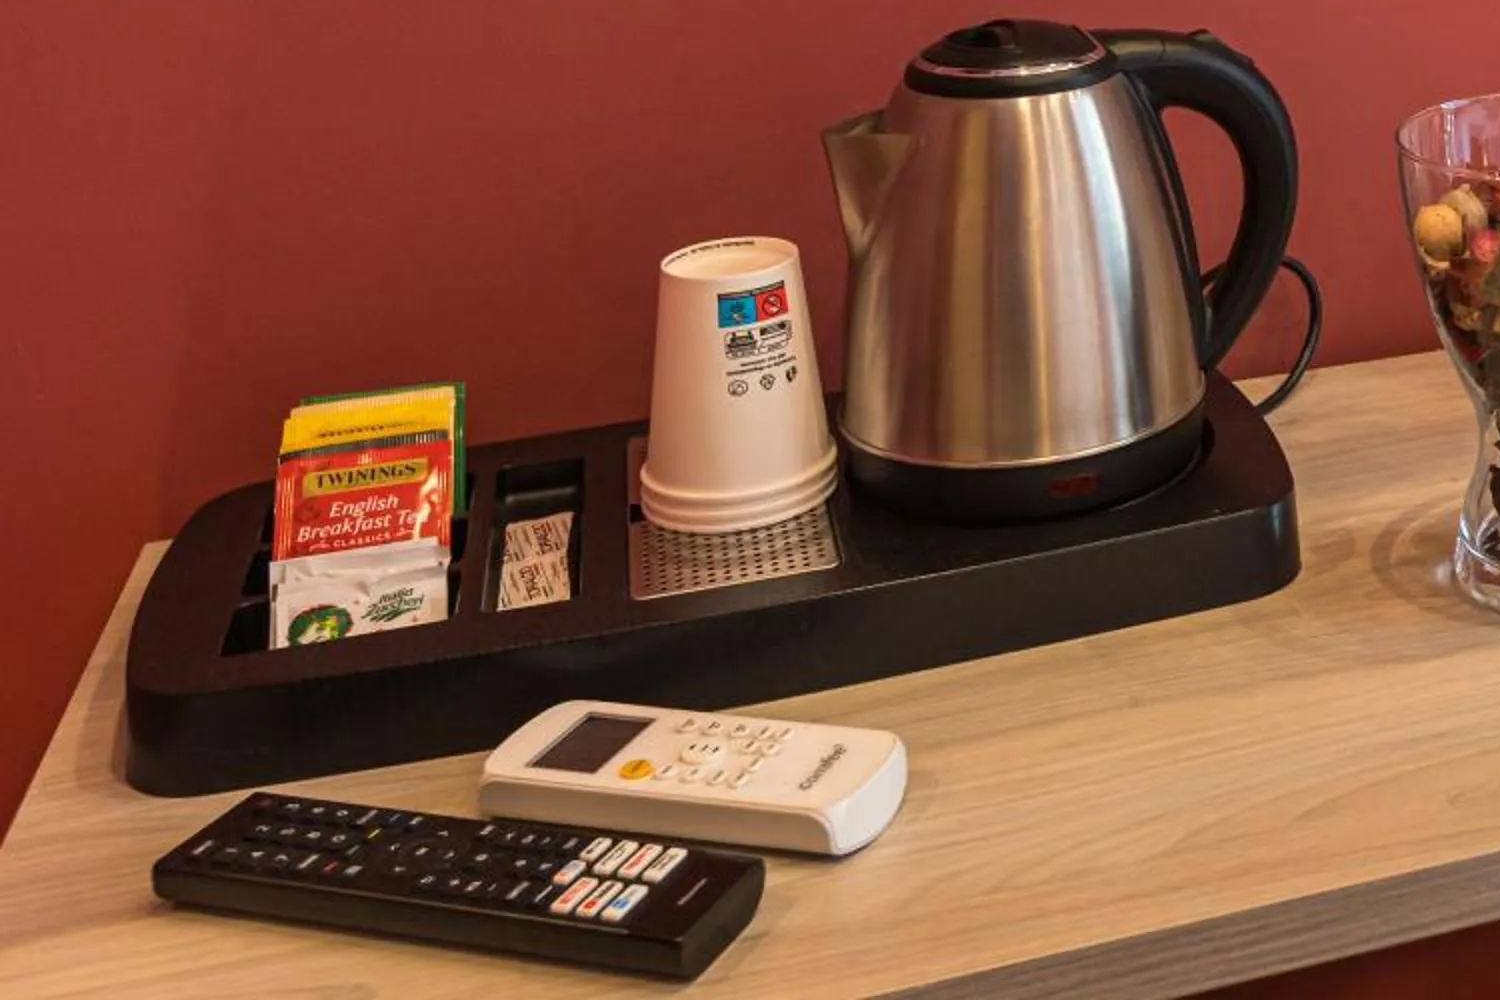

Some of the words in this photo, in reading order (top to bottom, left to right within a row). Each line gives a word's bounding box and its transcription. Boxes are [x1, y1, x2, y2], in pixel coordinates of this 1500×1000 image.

[316, 464, 416, 489] TWININGS
[329, 494, 399, 518] English
[296, 515, 392, 543] Breakfast
[397, 508, 430, 526] Tea
[333, 532, 391, 547] CLASSICS
